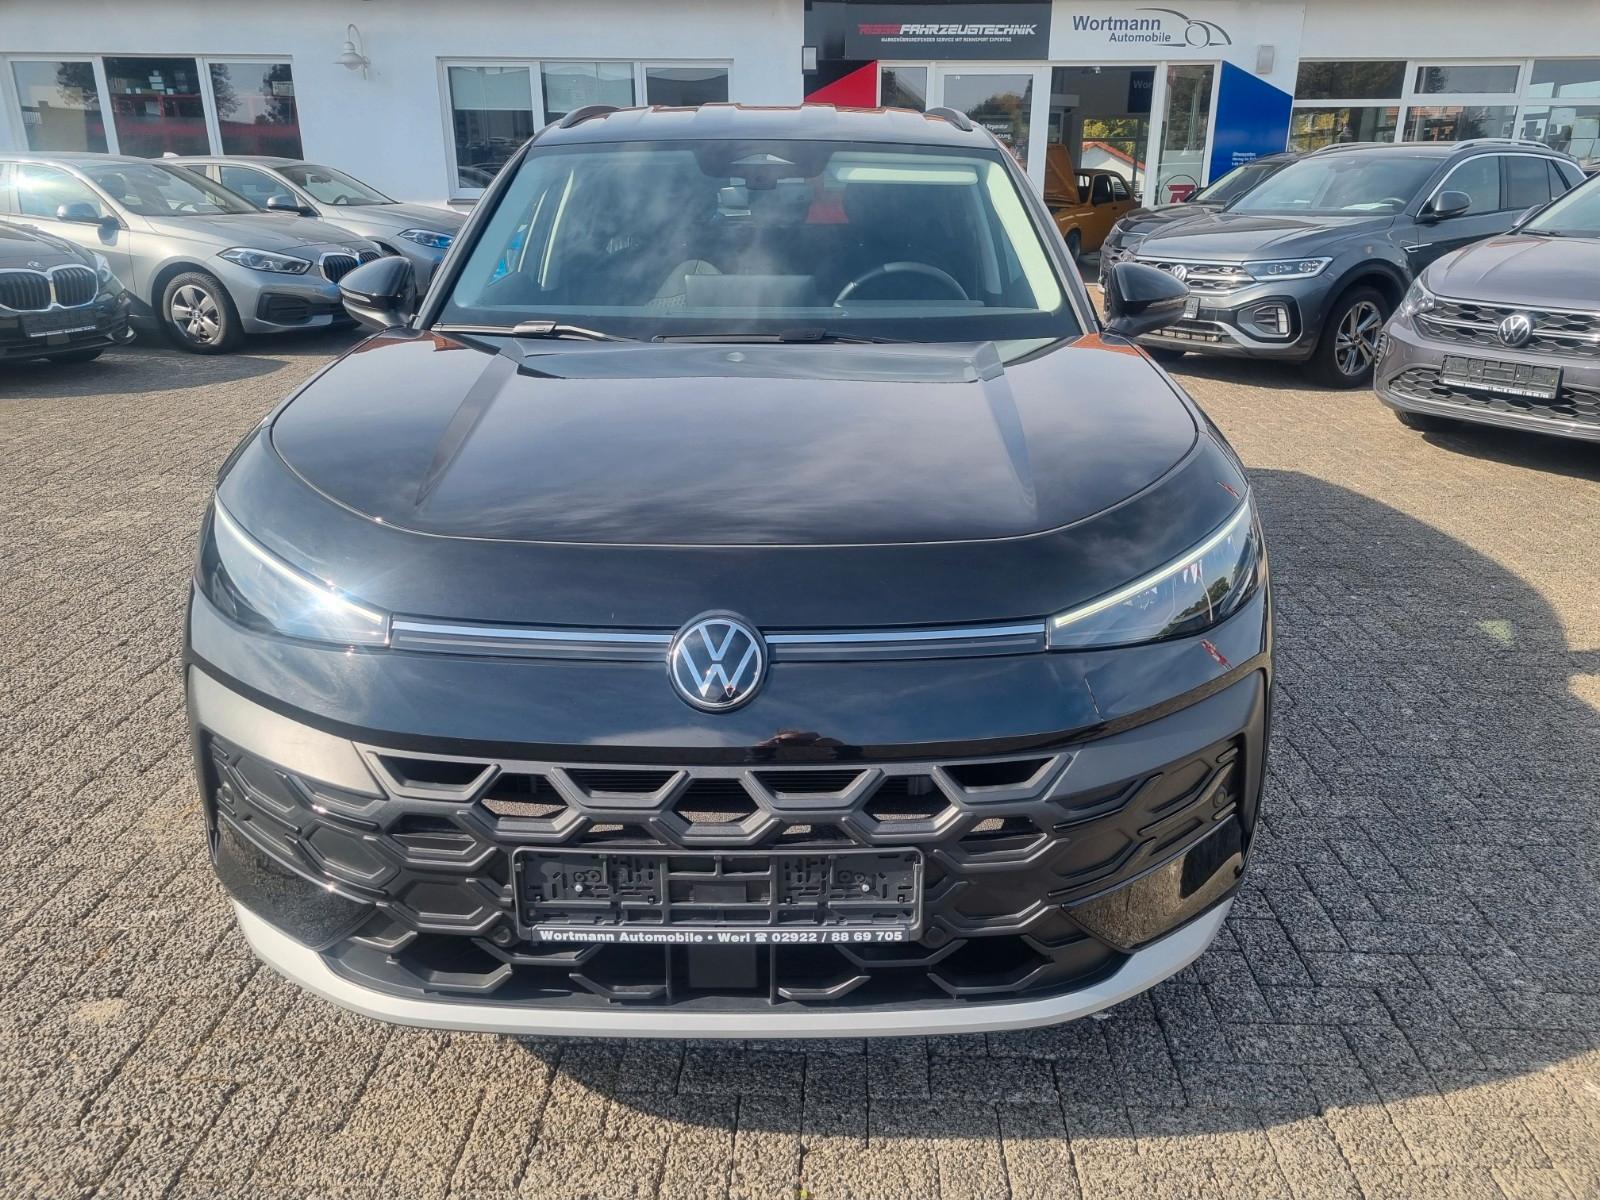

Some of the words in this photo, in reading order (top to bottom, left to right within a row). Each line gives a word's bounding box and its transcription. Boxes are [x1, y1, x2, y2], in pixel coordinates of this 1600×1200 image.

[1072, 15, 1161, 31] Wortmann
[1108, 32, 1172, 43] Automobile
[539, 930, 614, 941] Wortmann
[618, 931, 704, 943] Automobile
[717, 932, 750, 942] Werl
[771, 932, 817, 942] 02922
[831, 931, 849, 941] 88
[853, 931, 872, 941] 69
[876, 931, 903, 941] 705
